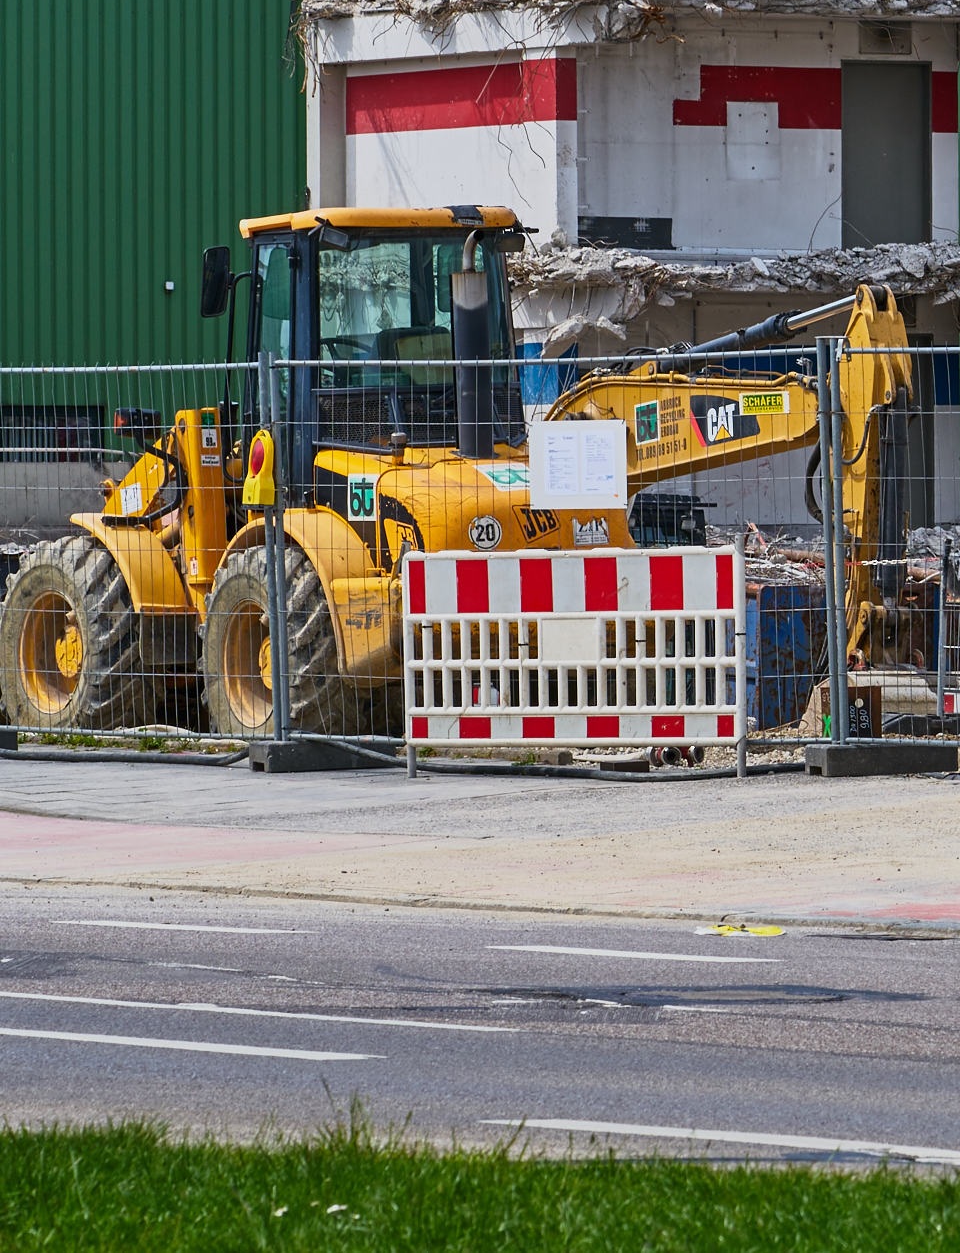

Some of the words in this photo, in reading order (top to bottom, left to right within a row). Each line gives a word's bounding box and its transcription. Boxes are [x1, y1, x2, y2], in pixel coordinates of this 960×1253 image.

[707, 403, 736, 442] CAT
[476, 524, 495, 542] 20
[519, 508, 557, 540] JCB
